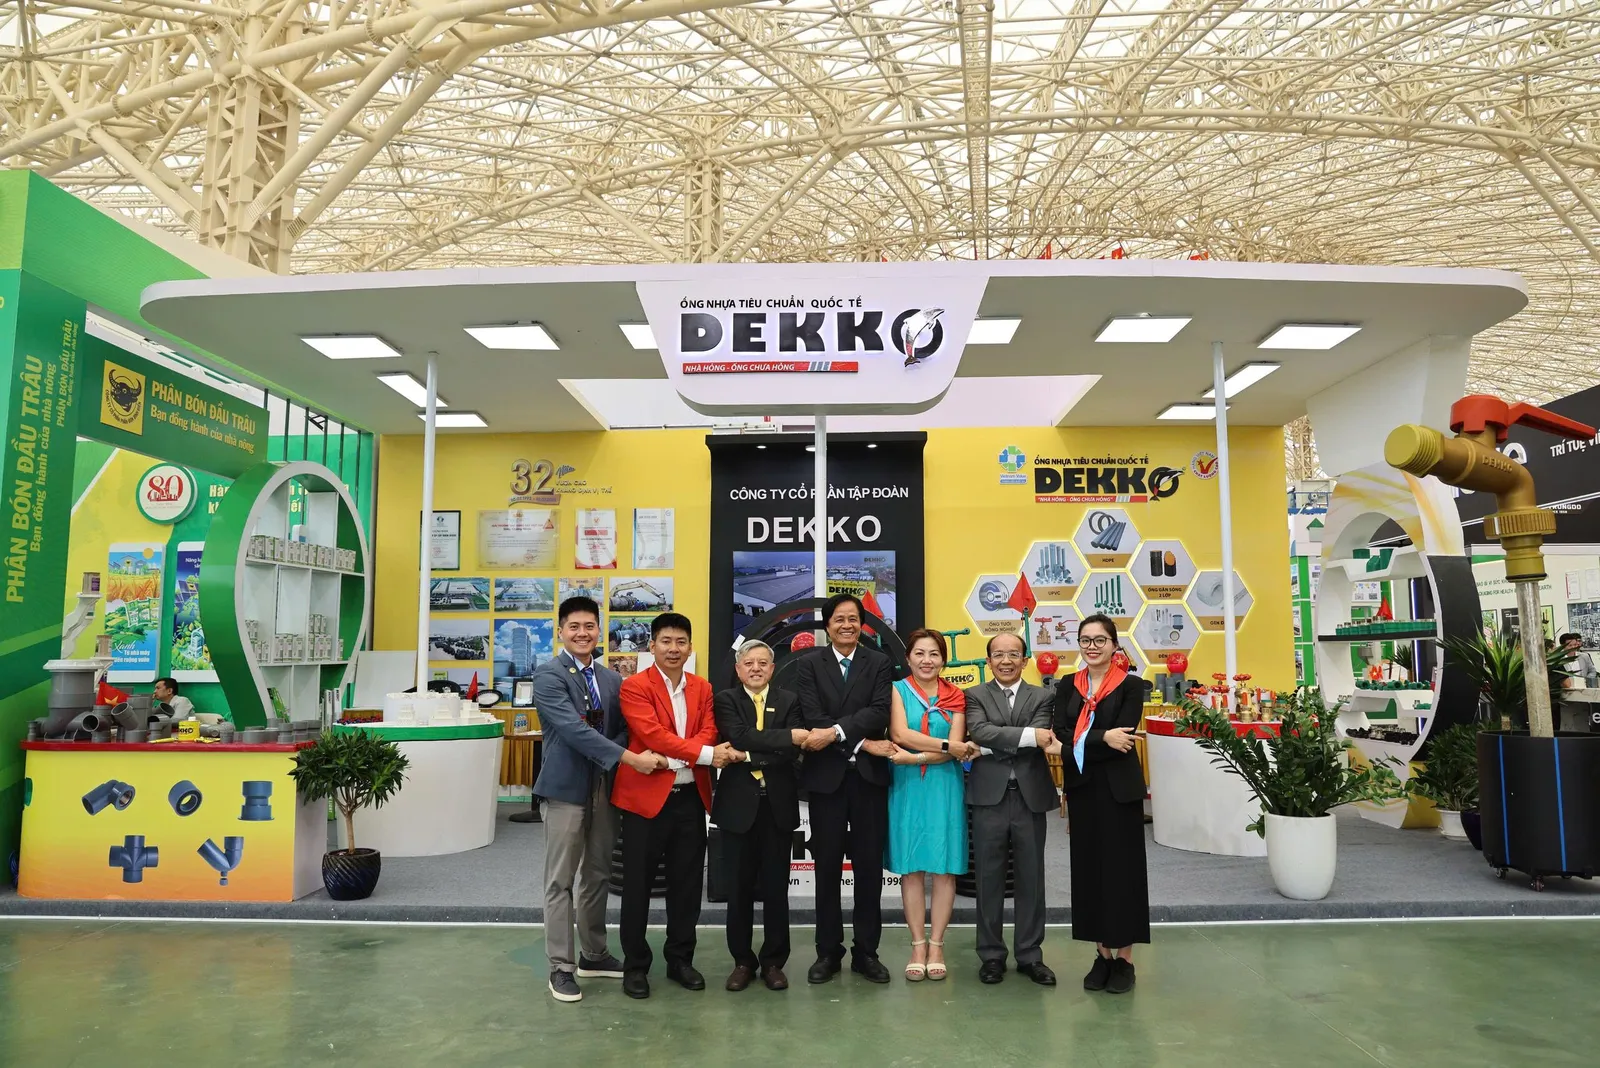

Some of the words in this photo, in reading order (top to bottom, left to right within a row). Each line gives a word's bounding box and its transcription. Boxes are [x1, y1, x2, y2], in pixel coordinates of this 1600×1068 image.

[680, 296, 704, 308] ỐNG
[706, 299, 736, 311] NHỰA
[739, 298, 762, 308] TIÊU
[766, 295, 804, 308] CHUẨN
[810, 296, 843, 308] QUỐC
[849, 296, 862, 308] TẾ
[681, 308, 945, 368] DEKKO
[44, 362, 57, 395] nông
[685, 364, 701, 372] NHÀ
[20, 354, 43, 417] TRÂU
[41, 398, 52, 422] nhà
[152, 380, 183, 407] PHÂN
[185, 393, 207, 417] BÓN
[209, 401, 229, 425] ĐẦU
[231, 414, 256, 435] TRÂU
[38, 426, 50, 450] của
[151, 404, 167, 422] Bạn
[169, 411, 188, 431] đồng
[190, 419, 209, 436] hành
[210, 427, 223, 441] của
[224, 433, 237, 446] nhà
[238, 439, 255, 454] nông
[11, 424, 37, 474] ĐẦU
[1034, 455, 1050, 465] ỐNG
[1051, 458, 1072, 467] NHỰA
[1073, 456, 1090, 465] TIÊU
[1091, 454, 1116, 465] CHUẨN
[1117, 455, 1138, 465] QUỐC
[1140, 454, 1149, 465] TẾ
[1550, 439, 1566, 457] TRÍ
[35, 453, 48, 486] hành
[510, 458, 555, 496] 32
[1034, 467, 1184, 501] DEKKO
[147, 475, 184, 502] 80
[730, 487, 767, 500] CÔNG
[770, 489, 786, 500] TY
[788, 483, 808, 500] CỔ
[811, 484, 846, 499] PẦN
[847, 486, 870, 500] TẬP
[872, 485, 909, 499] ĐOÀN
[9, 479, 33, 531] BÓN
[32, 490, 47, 522] đồng
[30, 526, 43, 552] Bạn
[747, 515, 882, 543] DEKKO
[4, 537, 28, 603] PHÂN
[829, 586, 867, 596] DEKKO
[942, 674, 974, 684] EKKO
